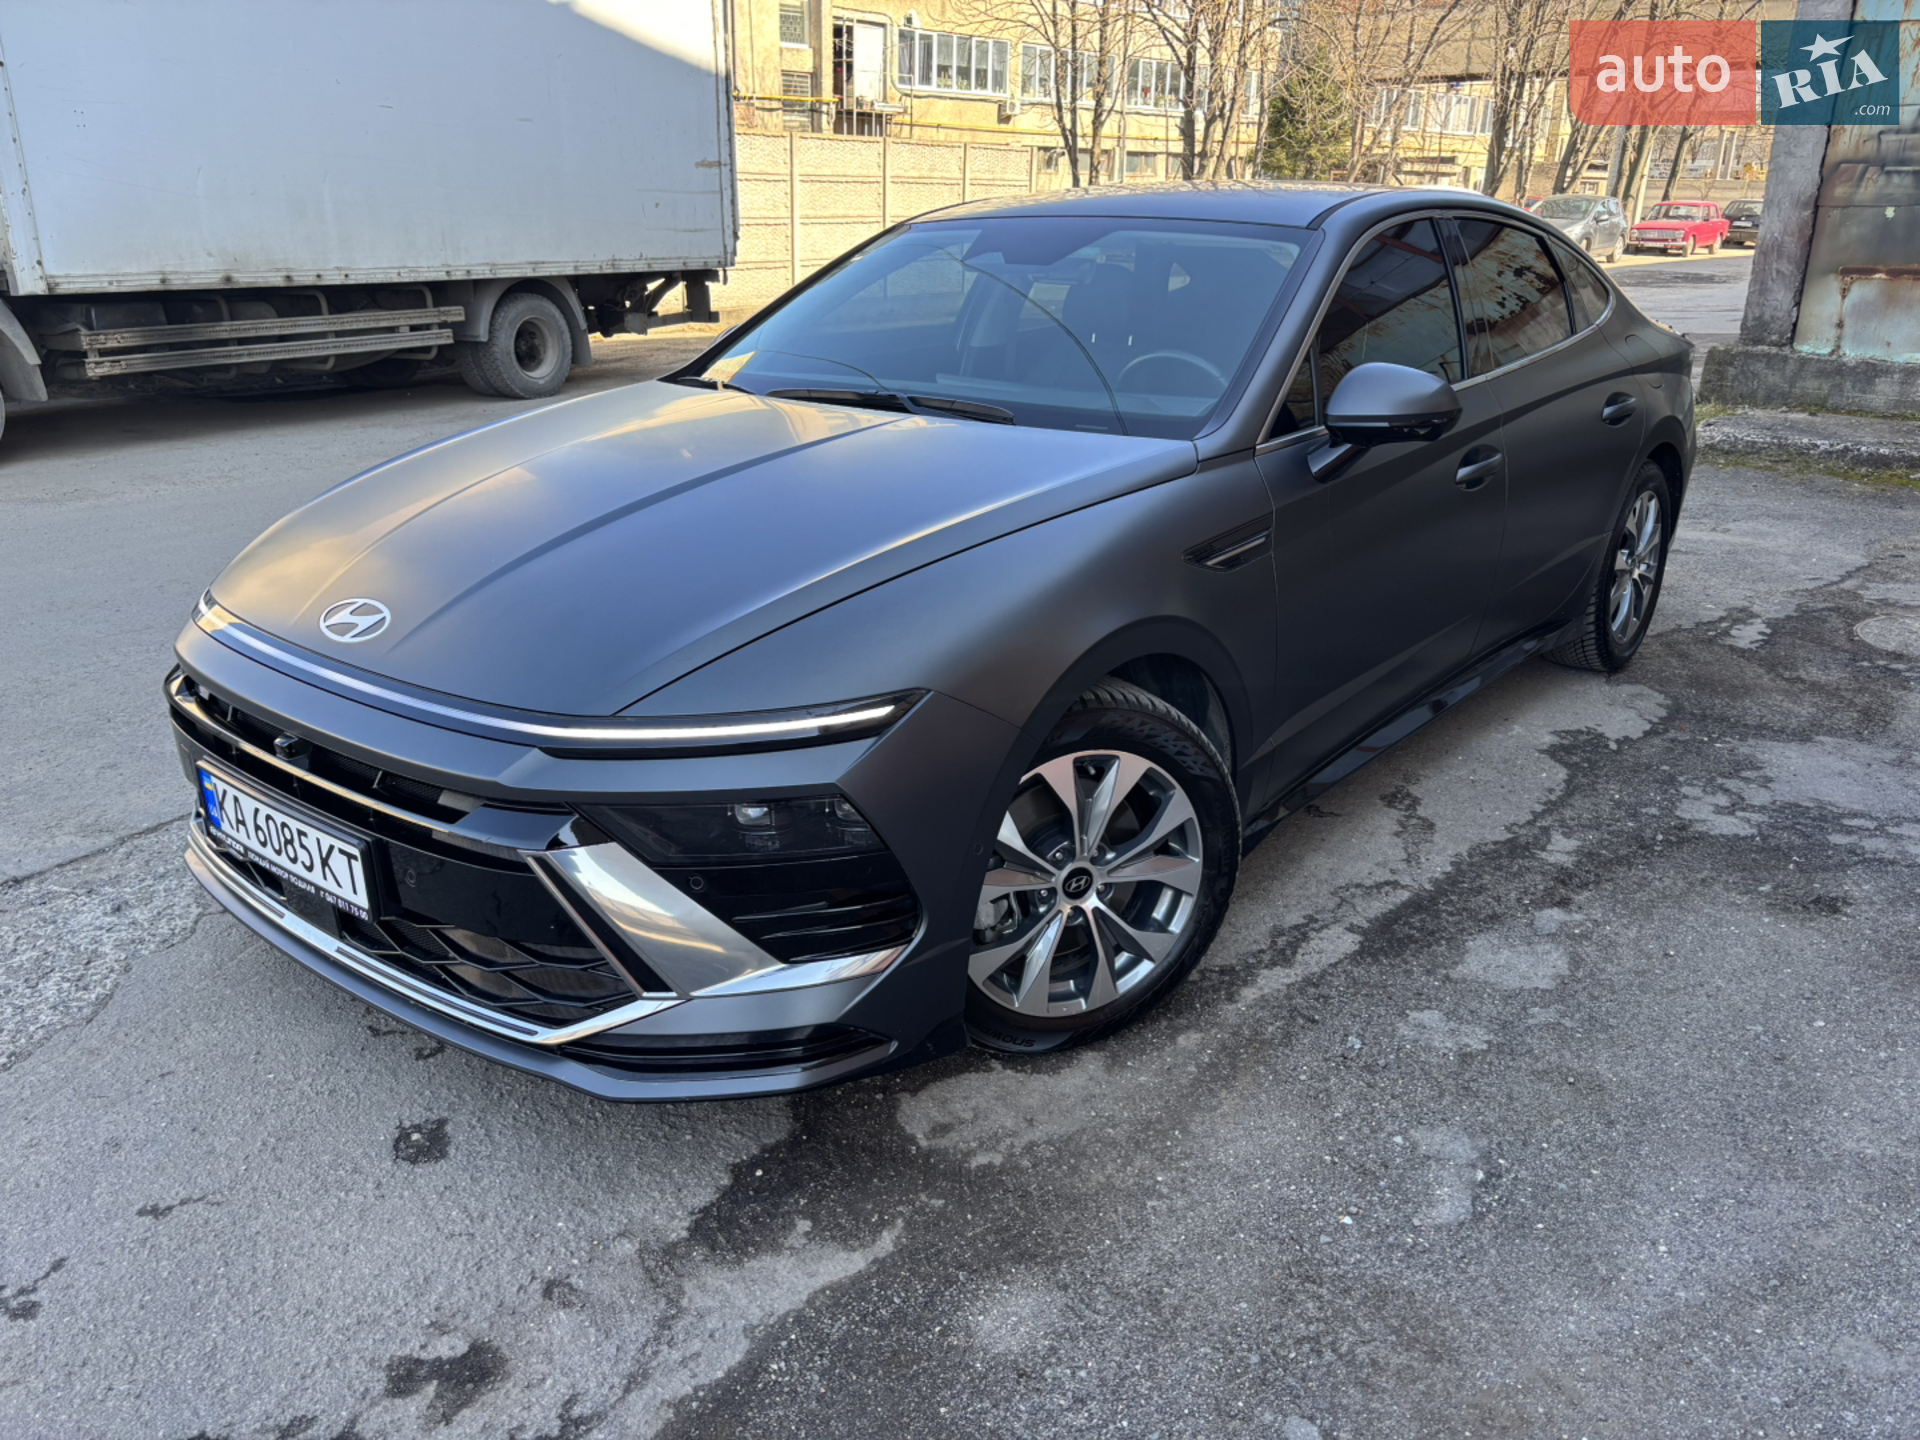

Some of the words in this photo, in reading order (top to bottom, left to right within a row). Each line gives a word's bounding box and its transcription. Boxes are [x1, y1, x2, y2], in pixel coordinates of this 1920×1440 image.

[213, 782, 251, 840] KA
[253, 807, 314, 873] 6085
[316, 837, 359, 896] KT
